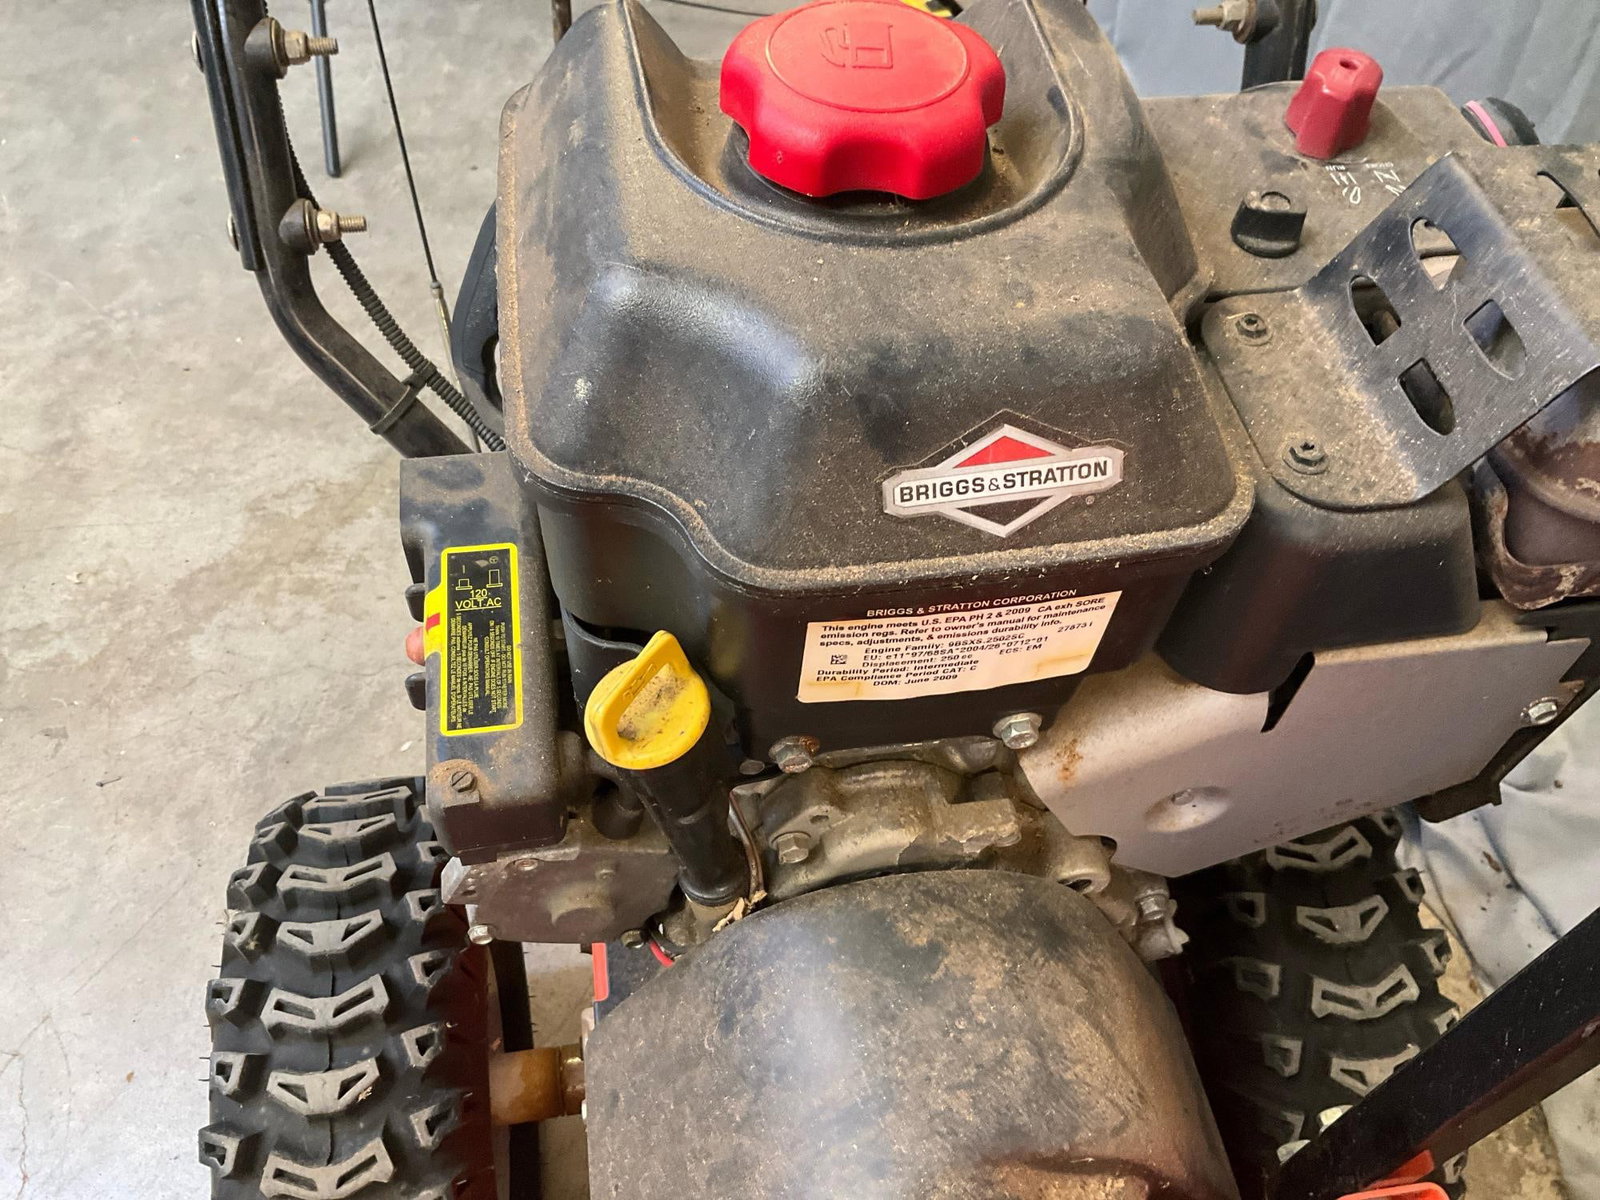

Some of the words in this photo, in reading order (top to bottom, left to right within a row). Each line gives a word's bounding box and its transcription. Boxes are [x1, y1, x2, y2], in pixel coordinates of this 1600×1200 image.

[1003, 460, 1108, 490] STRATTON
[470, 588, 488, 598] 120
[455, 599, 482, 610] VOLT
[486, 597, 502, 606] AC
[866, 608, 914, 617] BRIGGS
[928, 600, 990, 613] STRATTON
[993, 589, 1077, 606] CORPORATION
[848, 624, 884, 632] engine
[922, 618, 942, 626] U.S.
[945, 616, 966, 624] EPA
[986, 612, 993, 620] 2
[1006, 607, 1031, 616] 2009
[1054, 602, 1073, 610] exh
[1076, 597, 1106, 607] SORE
[820, 631, 869, 639] emission
[872, 630, 898, 638] regs.
[900, 628, 928, 636] Refer
[944, 622, 984, 632] owner's
[987, 618, 1026, 628] manual
[1026, 614, 1041, 622] for
[1043, 604, 1106, 618] maintenance
[820, 640, 854, 648] specs,
[856, 636, 924, 646] adjustments,
[937, 629, 988, 640] emissions
[991, 622, 1040, 634] durability
[1041, 619, 1062, 628] info.
[865, 646, 901, 655] Engine
[905, 643, 944, 652] Family:
[1026, 644, 1043, 652] EM
[817, 668, 869, 676] Durability
[872, 666, 910, 674] Period:
[914, 660, 980, 671] Intermediate
[862, 658, 936, 668] Displacement:
[840, 672, 902, 682] Compliance
[905, 669, 940, 678] Period
[904, 676, 930, 685] June
